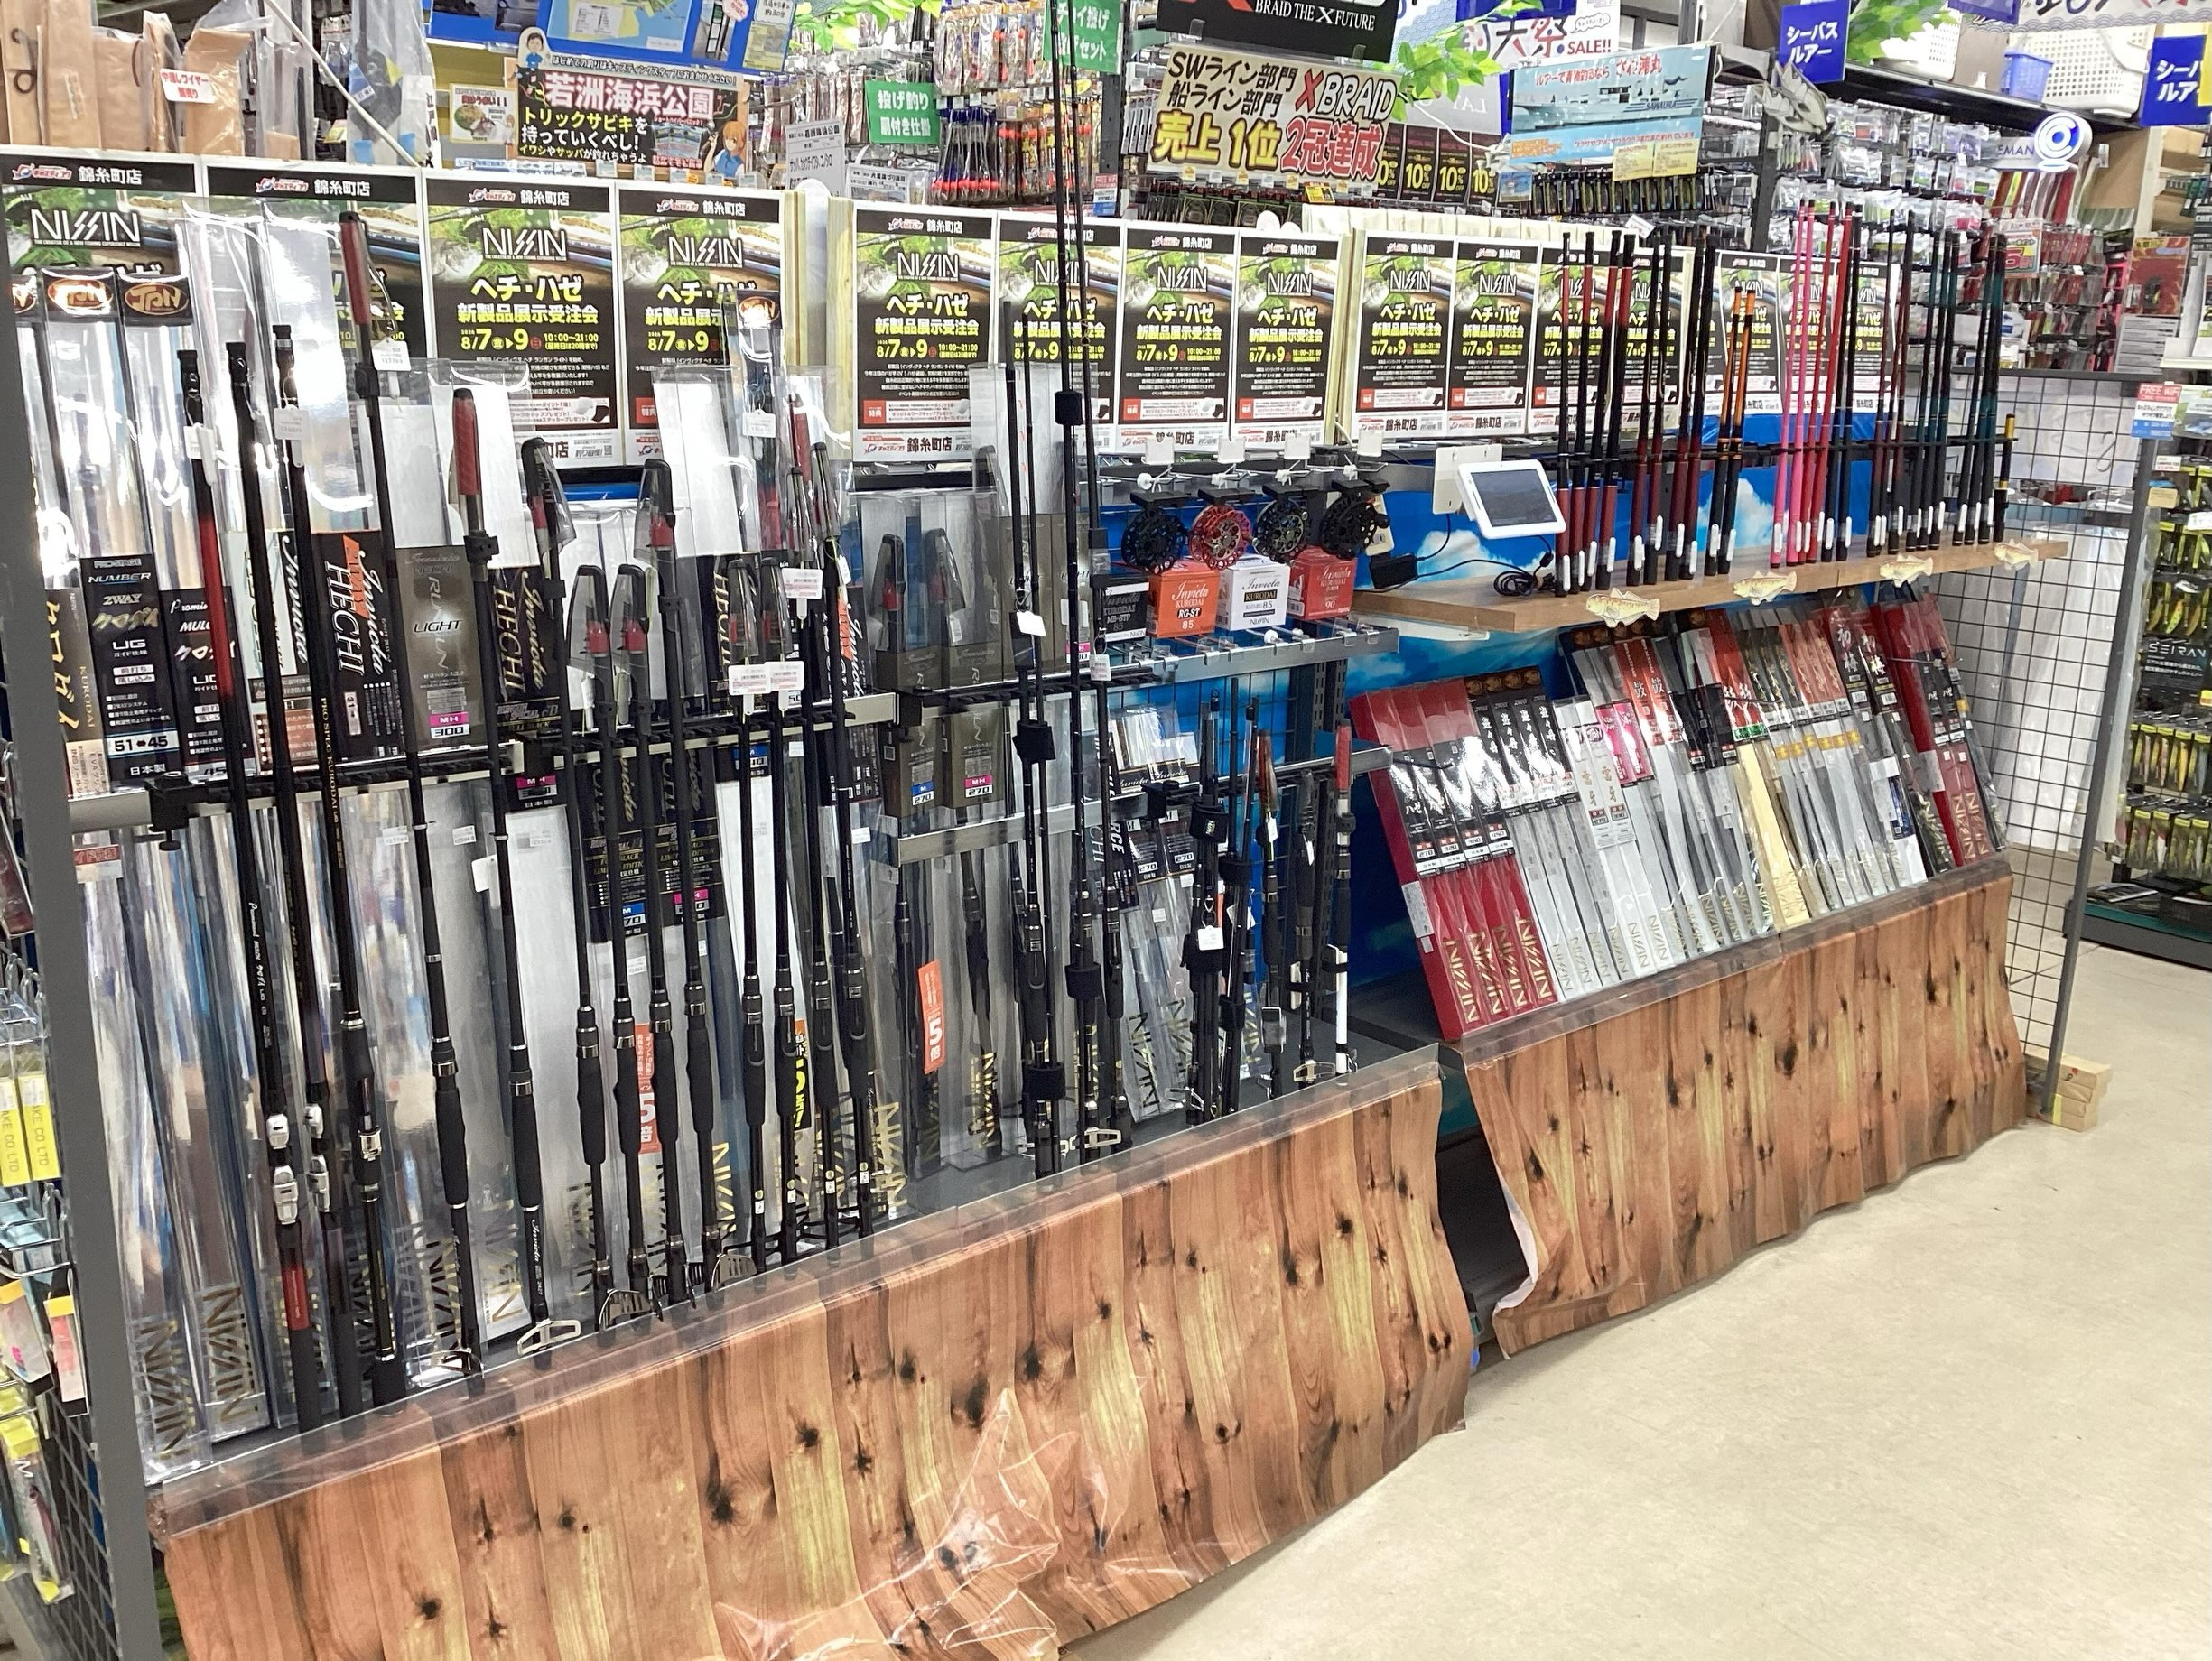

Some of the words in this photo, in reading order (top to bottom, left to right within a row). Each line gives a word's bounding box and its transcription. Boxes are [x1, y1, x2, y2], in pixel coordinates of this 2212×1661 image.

[1255, 0, 1293, 15] BRAID
[1295, 5, 1315, 20] THE
[1316, 8, 1335, 24] X
[1335, 13, 1375, 31] FUTURE
[1787, 23, 1838, 44] シーバス
[1567, 40, 1612, 55] SALE!!
[1789, 44, 1832, 65] ルアー
[1169, 51, 1298, 91] SWライン部門
[2156, 59, 2200, 80] シー
[544, 72, 716, 122] 若洲海浜公園
[878, 89, 929, 111] 投げ釣り
[1167, 80, 1282, 119] 船ライン部門
[1294, 69, 1398, 120] XBRAID
[2158, 81, 2200, 101] ルア
[524, 107, 648, 135] トリックサビキを
[521, 125, 640, 152] 持っていくべし!
[1280, 116, 1383, 181] 2冠達成
[519, 145, 647, 163] イワシやサッパが釣れちゃうよ
[79, 166, 142, 184] 錦糸町店
[314, 179, 370, 196] 錦糸町店
[521, 190, 570, 207] 錦糸町店
[702, 200, 746, 217] 錦糸町店
[927, 219, 962, 234] 錦糸町店
[482, 227, 566, 256] NISSIN
[669, 237, 743, 264] NISSIN
[897, 253, 959, 278] NISSIN
[1157, 266, 1207, 290] NISSIN
[1268, 273, 1313, 294] NISSIN
[470, 275, 584, 302] ヘチ・ハゼ
[457, 302, 599, 325] 新製品展示受注会
[886, 292, 970, 317] ヘチ・ハゼ
[1147, 302, 1216, 324] ヘチ・ハゼ
[1380, 302, 1436, 321] ヘチ・ハゼ
[875, 317, 979, 337] 新製品展示受注会
[1258, 307, 1317, 327] ヘチ・ハゼ
[1385, 417, 1417, 431] 錦糸町店
[907, 437, 953, 452] 錦糸町店
[88, 572, 151, 583] NUMBER
[103, 593, 143, 606] 2WAY
[1172, 580, 1210, 601] Invicta
[1245, 590, 1277, 601] KURODAI
[1176, 598, 1204, 608] KURODAI
[324, 561, 365, 676] HECHI
[1178, 608, 1201, 619] RG-ST
[414, 620, 464, 633] LIGHT
[1182, 620, 1194, 630] 85
[494, 586, 526, 693] HECHI
[79, 666, 95, 728] KURODAI
[440, 715, 459, 723] MH
[115, 739, 134, 752] 51
[148, 736, 168, 747] 45
[130, 764, 165, 775] 日本製
[914, 795, 932, 804] 270
[968, 785, 990, 795] 270
[1139, 863, 1156, 872] 270
[1176, 854, 1193, 862] 270
[5, 1135, 15, 1148] CO
[34, 1128, 45, 1142] CO
[37, 1150, 49, 1166] LTD
